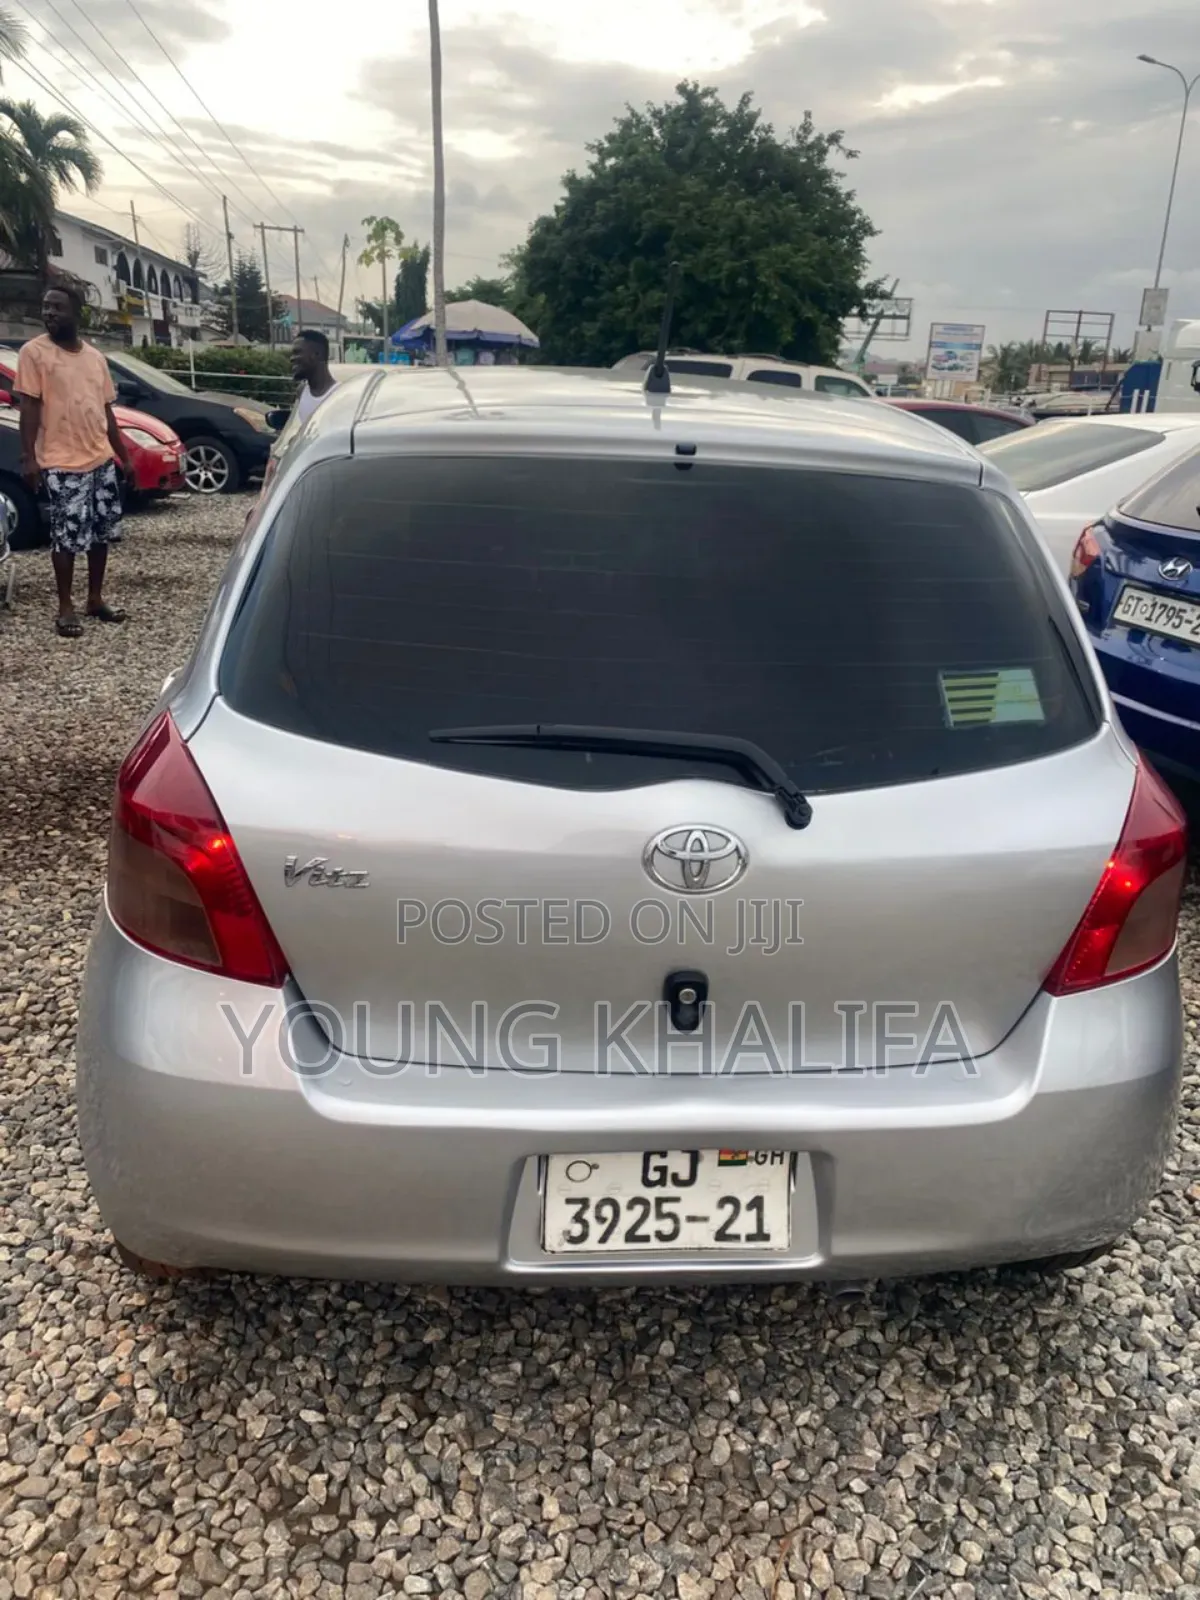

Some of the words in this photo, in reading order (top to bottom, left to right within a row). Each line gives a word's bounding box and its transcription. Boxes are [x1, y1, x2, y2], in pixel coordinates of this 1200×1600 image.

[1121, 594, 1144, 617] GT
[284, 854, 370, 888] Vitz
[641, 1150, 699, 1188] GJ
[754, 1151, 785, 1165] GH
[564, 1195, 771, 1245] 3925-21
